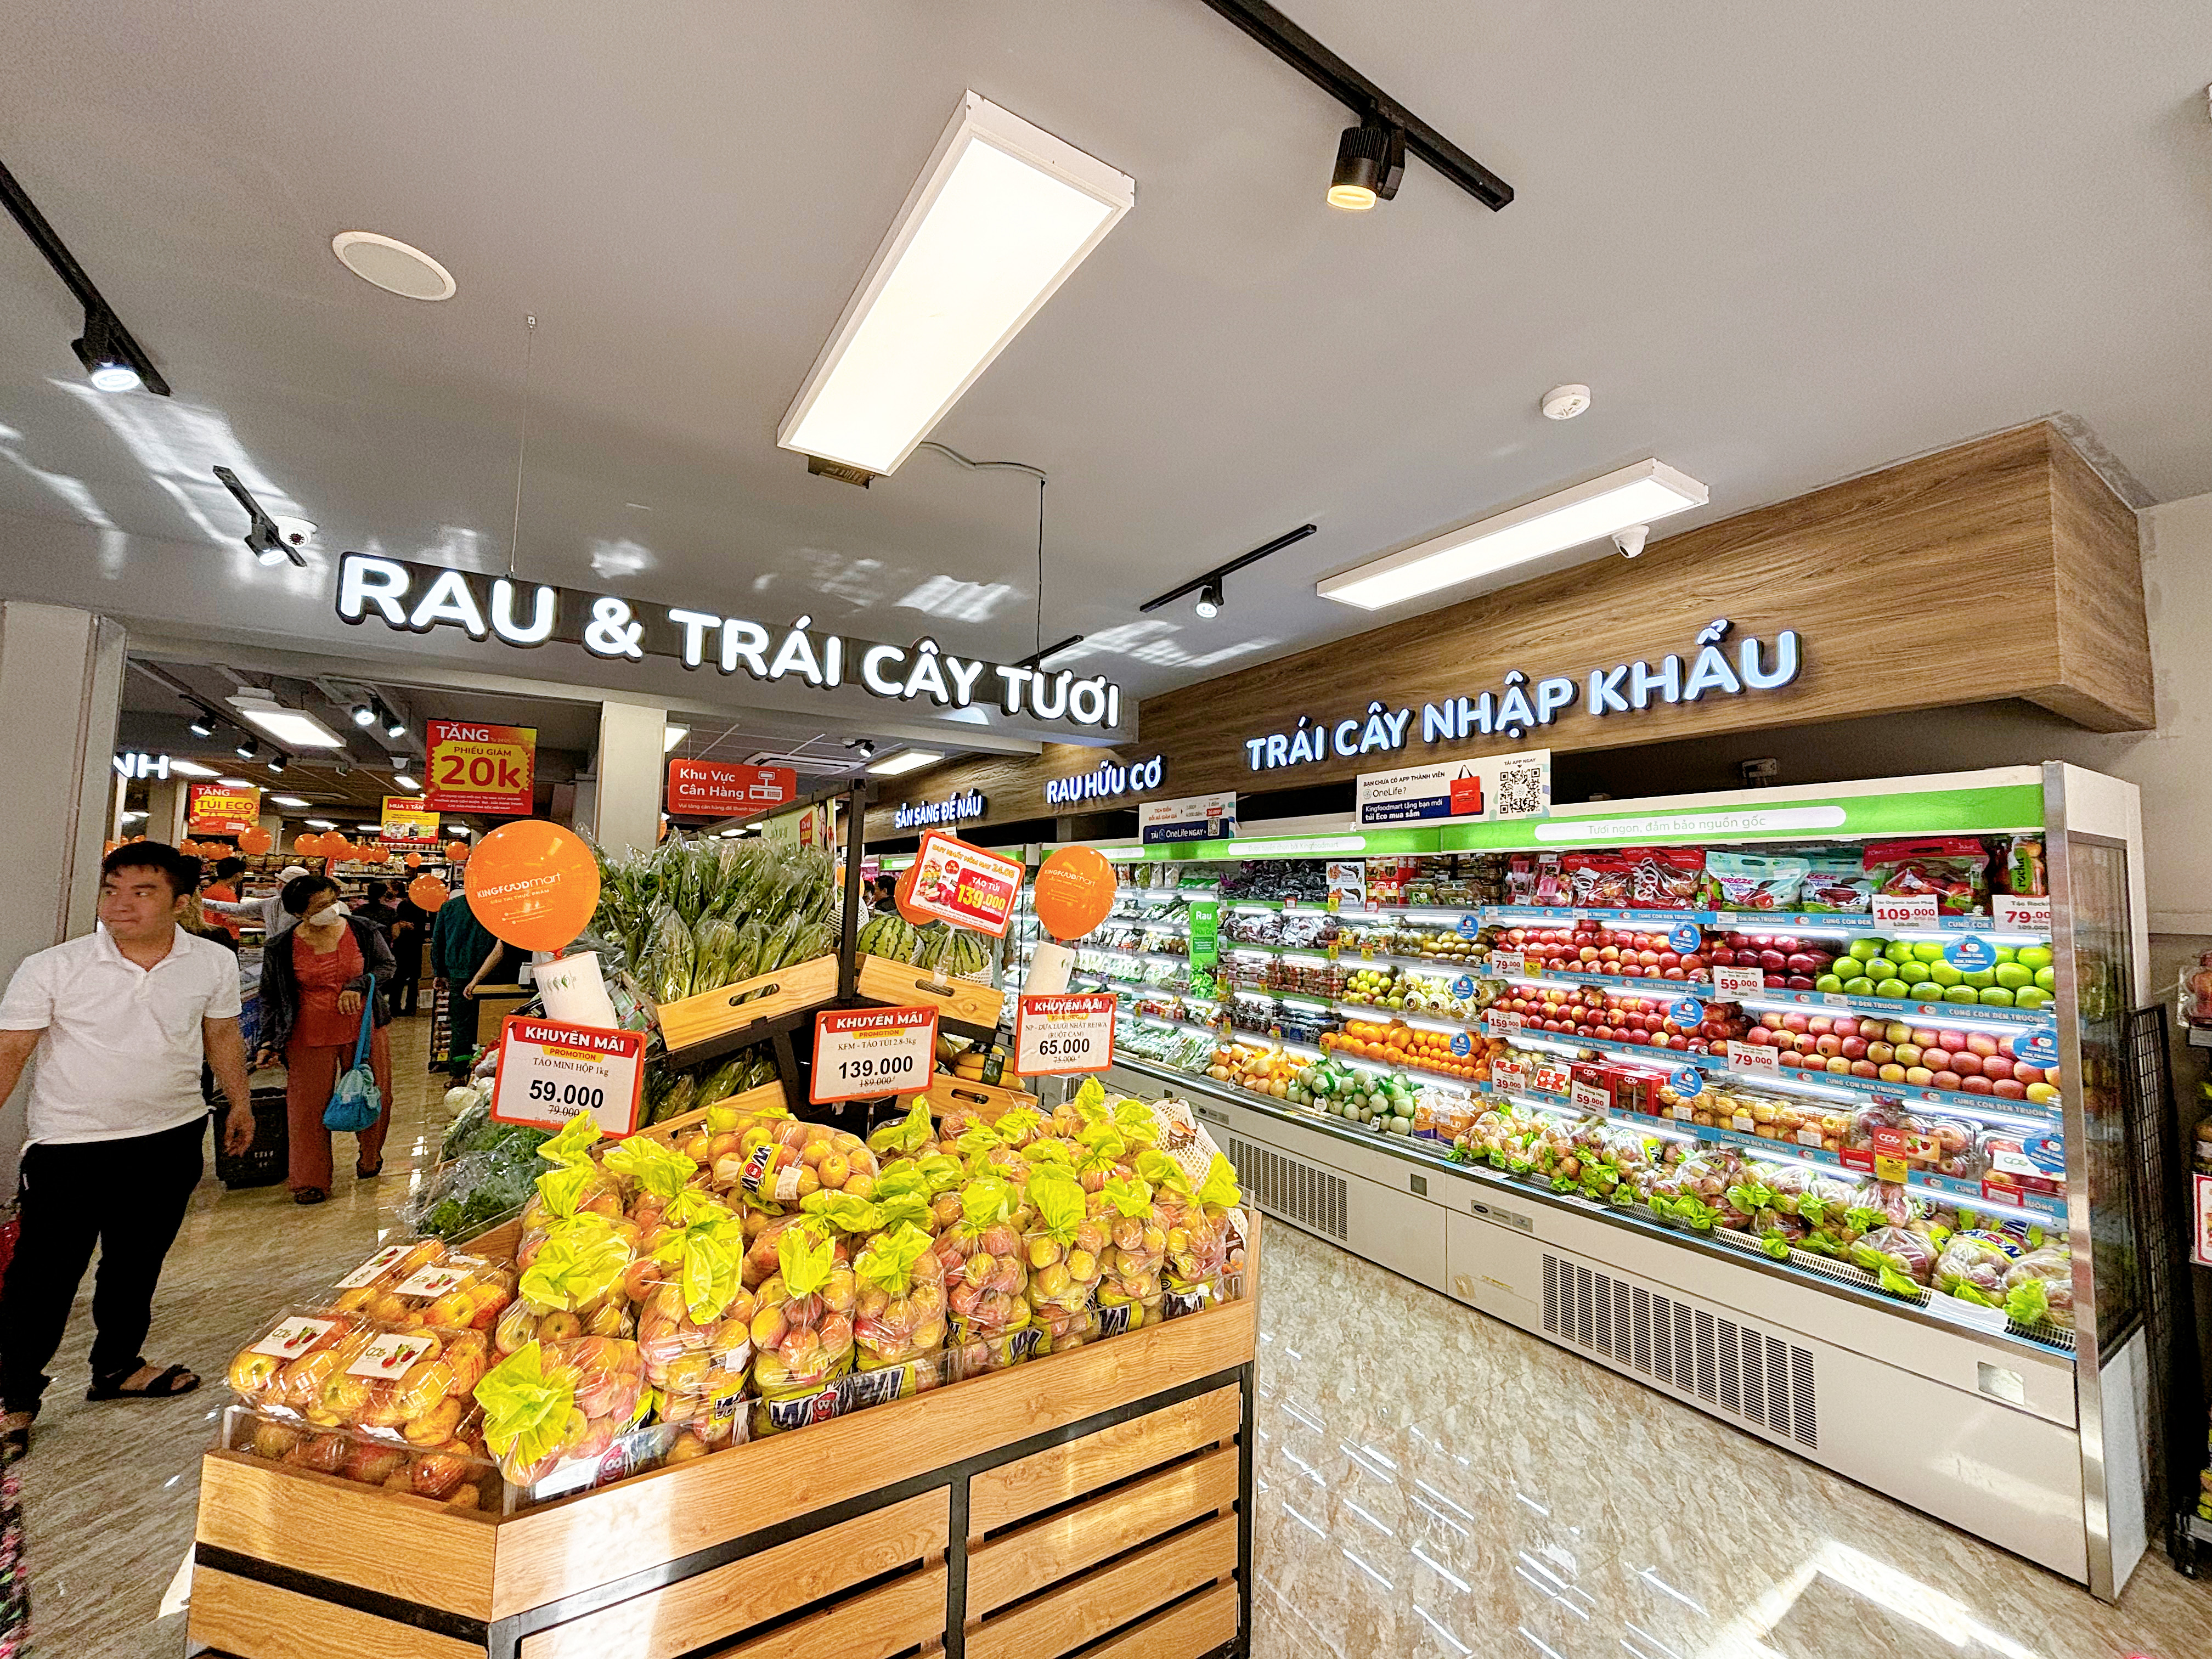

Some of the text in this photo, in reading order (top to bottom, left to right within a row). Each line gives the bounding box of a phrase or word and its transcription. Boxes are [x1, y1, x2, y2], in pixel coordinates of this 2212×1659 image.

[338, 554, 1120, 728] RAU & TRÁI CÂY TƯƠI
[1246, 619, 1799, 770] TRÁI CÂY NHẬP KHẨU
[454, 746, 512, 757] PHIẾU GIẢM
[440, 755, 521, 788] 20k
[680, 767, 736, 785] Khu Vực
[1410, 774, 1431, 782] THÀNH
[1432, 770, 1445, 778] VIÊN
[1046, 754, 1163, 804] RAU HỮU CƠ
[679, 783, 744, 800] Cân Hàng
[198, 798, 254, 810] TÚI ECO
[914, 800, 940, 826] SÀNG
[956, 788, 983, 819] NẤU
[1365, 798, 1443, 812] Kingfoodmart tặng bạn mới
[1365, 812, 1375, 821] túi
[1376, 812, 1388, 821] Eco
[1405, 809, 1420, 818] sắm
[1587, 814, 1767, 837] Tươi ngon, đảm bảo nguồn gốc
[1150, 830, 1159, 839] TẢI
[1166, 828, 1188, 838] OneLife
[1300, 841, 1339, 851] Kingfoodmart
[972, 876, 1001, 892] TÁO TÚI
[957, 884, 1006, 911] 139.000
[1196, 911, 1212, 920] Rau
[1877, 908, 1935, 920] 109.000
[2005, 911, 2051, 923] 79.00
[1496, 960, 1520, 969] 79.000
[1720, 978, 1757, 990] 59.000
[837, 1011, 923, 1029] KHUYẾN MÃI
[1491, 1018, 1519, 1028] 159.000
[524, 1025, 625, 1052] KHUYẾN MÃI
[859, 1029, 900, 1038] PROMOTION
[1048, 1031, 1066, 1039] (RUỘT
[838, 1042, 855, 1051] KFM
[862, 1040, 878, 1048] TÁO
[879, 1038, 893, 1047] TÚI
[893, 1037, 917, 1046] 2.8-3kg
[1040, 1038, 1090, 1056] 65.000
[549, 1048, 597, 1061] PROMOTION
[1734, 1053, 1773, 1065] 79.000
[533, 1057, 609, 1077] TÁO MINI HỘP 1kg
[838, 1055, 914, 1080] 139.000
[1496, 1079, 1521, 1088] 39.000
[1846, 1080, 1860, 1088] CON
[529, 1079, 604, 1109] 59.000
[1577, 1093, 1604, 1105] 59.000
